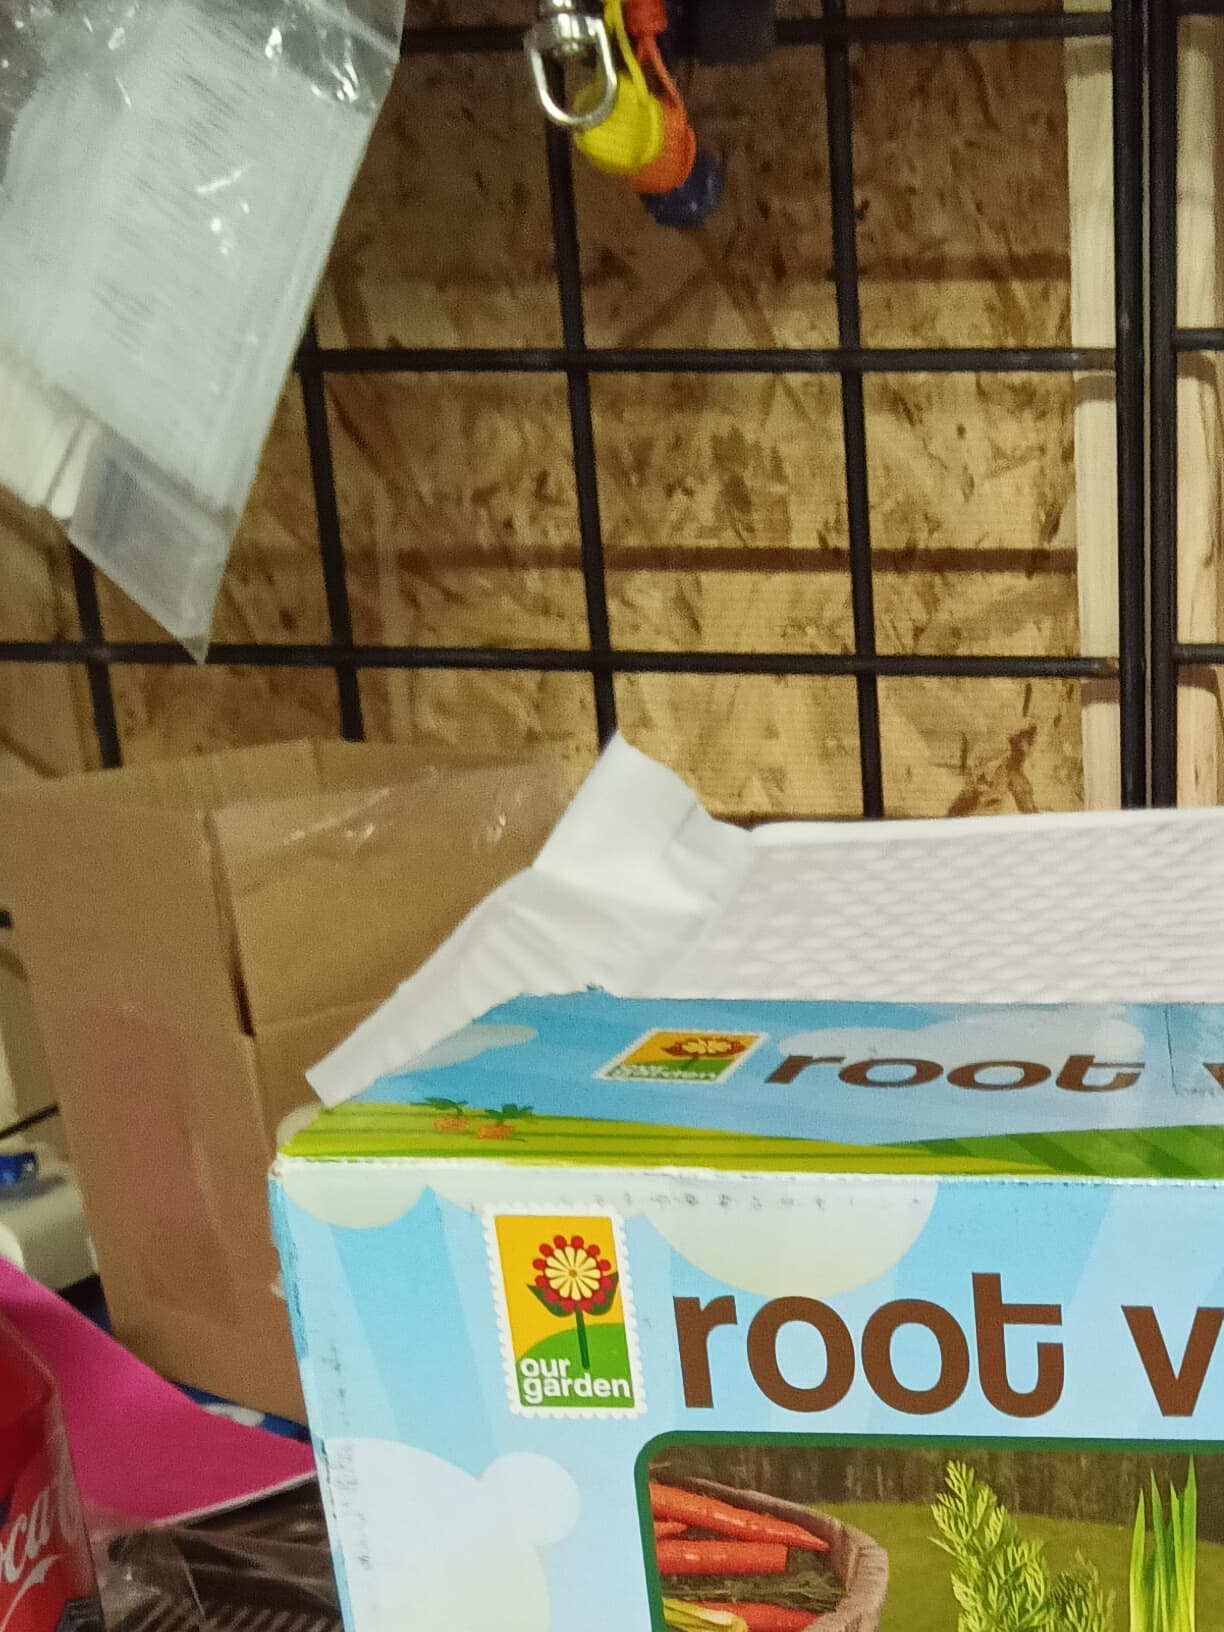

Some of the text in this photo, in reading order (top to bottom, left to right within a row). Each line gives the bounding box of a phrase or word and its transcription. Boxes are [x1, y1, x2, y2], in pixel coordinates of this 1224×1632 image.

[764, 1053, 1145, 1094] root
[673, 1273, 1065, 1418] root
[520, 1357, 571, 1378] our
[523, 1372, 632, 1405] garden
